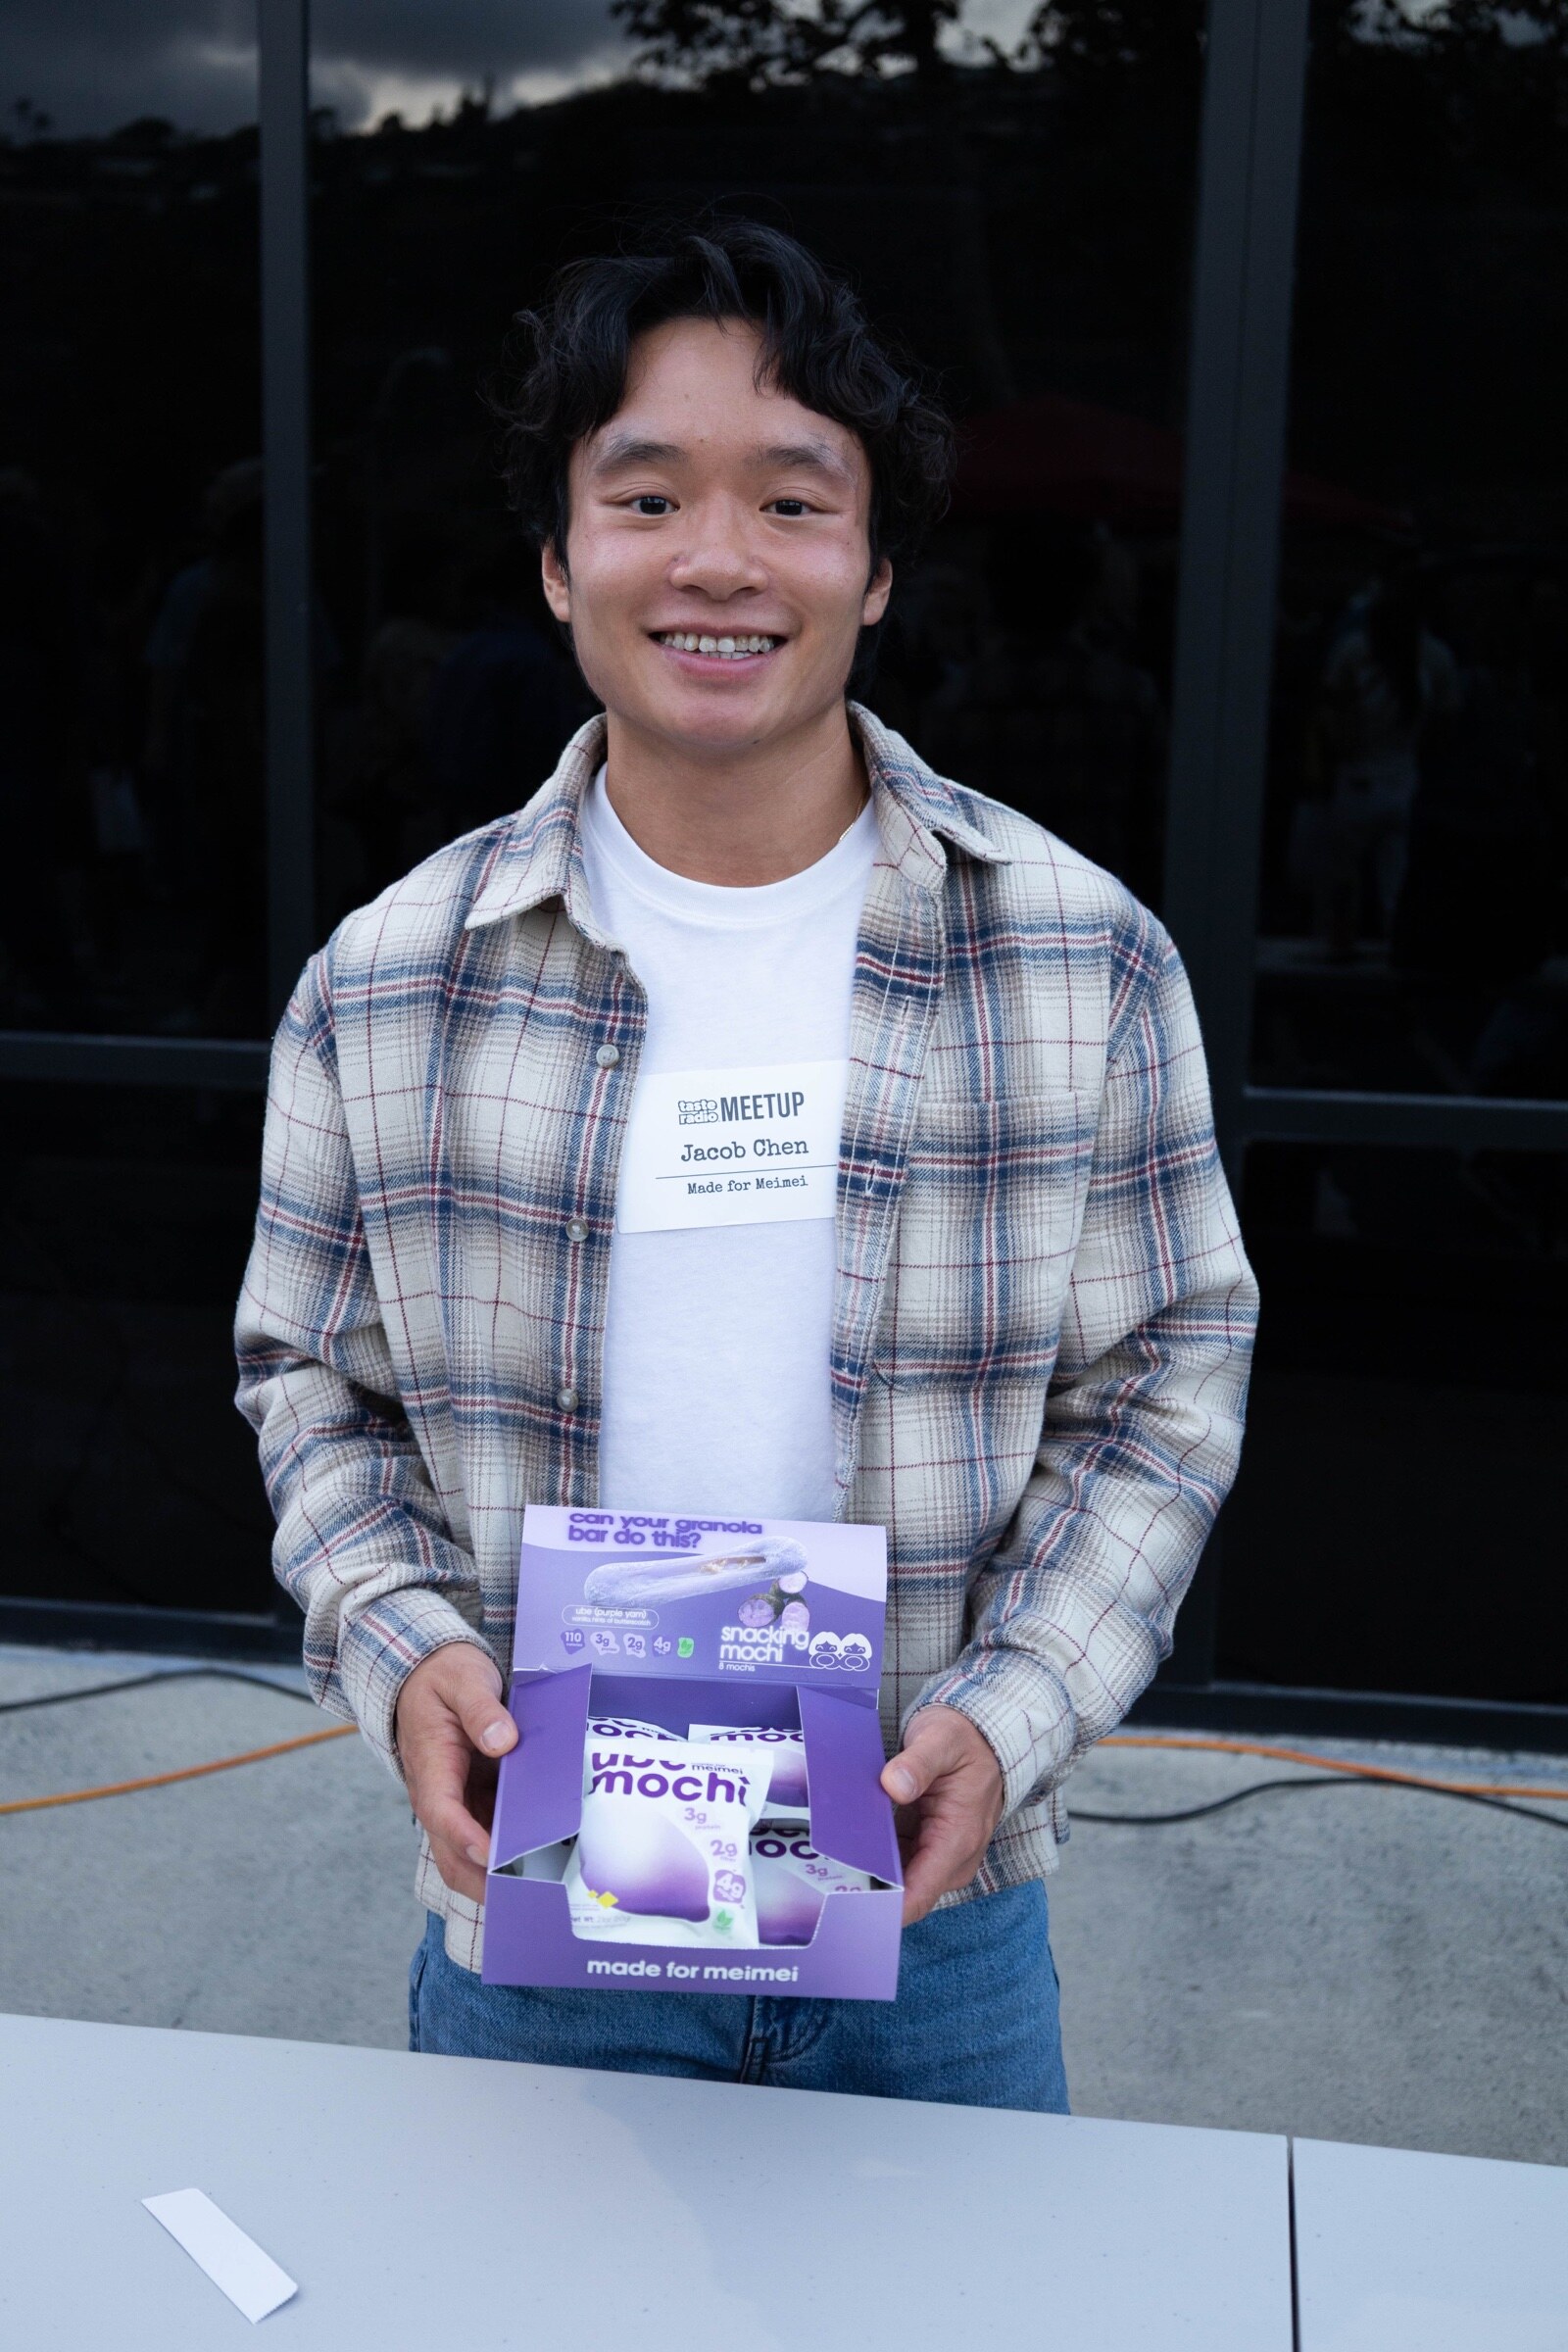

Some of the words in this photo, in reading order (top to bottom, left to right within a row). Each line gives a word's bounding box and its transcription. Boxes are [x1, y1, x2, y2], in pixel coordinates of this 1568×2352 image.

[678, 1100, 717, 1113] taste
[720, 1092, 805, 1122] MEETUP
[679, 1110, 718, 1125] radio
[681, 1142, 746, 1162] Jacob
[753, 1139, 809, 1156] Chen
[687, 1182, 723, 1195] Made
[727, 1180, 752, 1192] for
[756, 1175, 808, 1189] Meimei
[569, 1512, 613, 1525] can
[620, 1515, 669, 1529] your
[675, 1518, 762, 1535] granola
[568, 1525, 608, 1543] bar
[613, 1528, 646, 1545] do
[652, 1530, 702, 1548] this?
[575, 1608, 592, 1617] ube
[594, 1607, 623, 1618] (purple
[564, 1632, 582, 1642] 110
[596, 1634, 610, 1646] 3g
[627, 1638, 643, 1650] 2g
[654, 1637, 671, 1651] 4g
[720, 1625, 809, 1650] snacking
[719, 1643, 783, 1662] mochi
[726, 1663, 755, 1672] mochis
[692, 1764, 743, 1775] meimei
[589, 1771, 751, 1807] mochi
[684, 1807, 707, 1825] 3g
[710, 1838, 737, 1857] 2g
[806, 1863, 828, 1877] 3g
[587, 1960, 662, 1977] made
[666, 1962, 699, 1978] for
[704, 1966, 799, 1982] meimei
